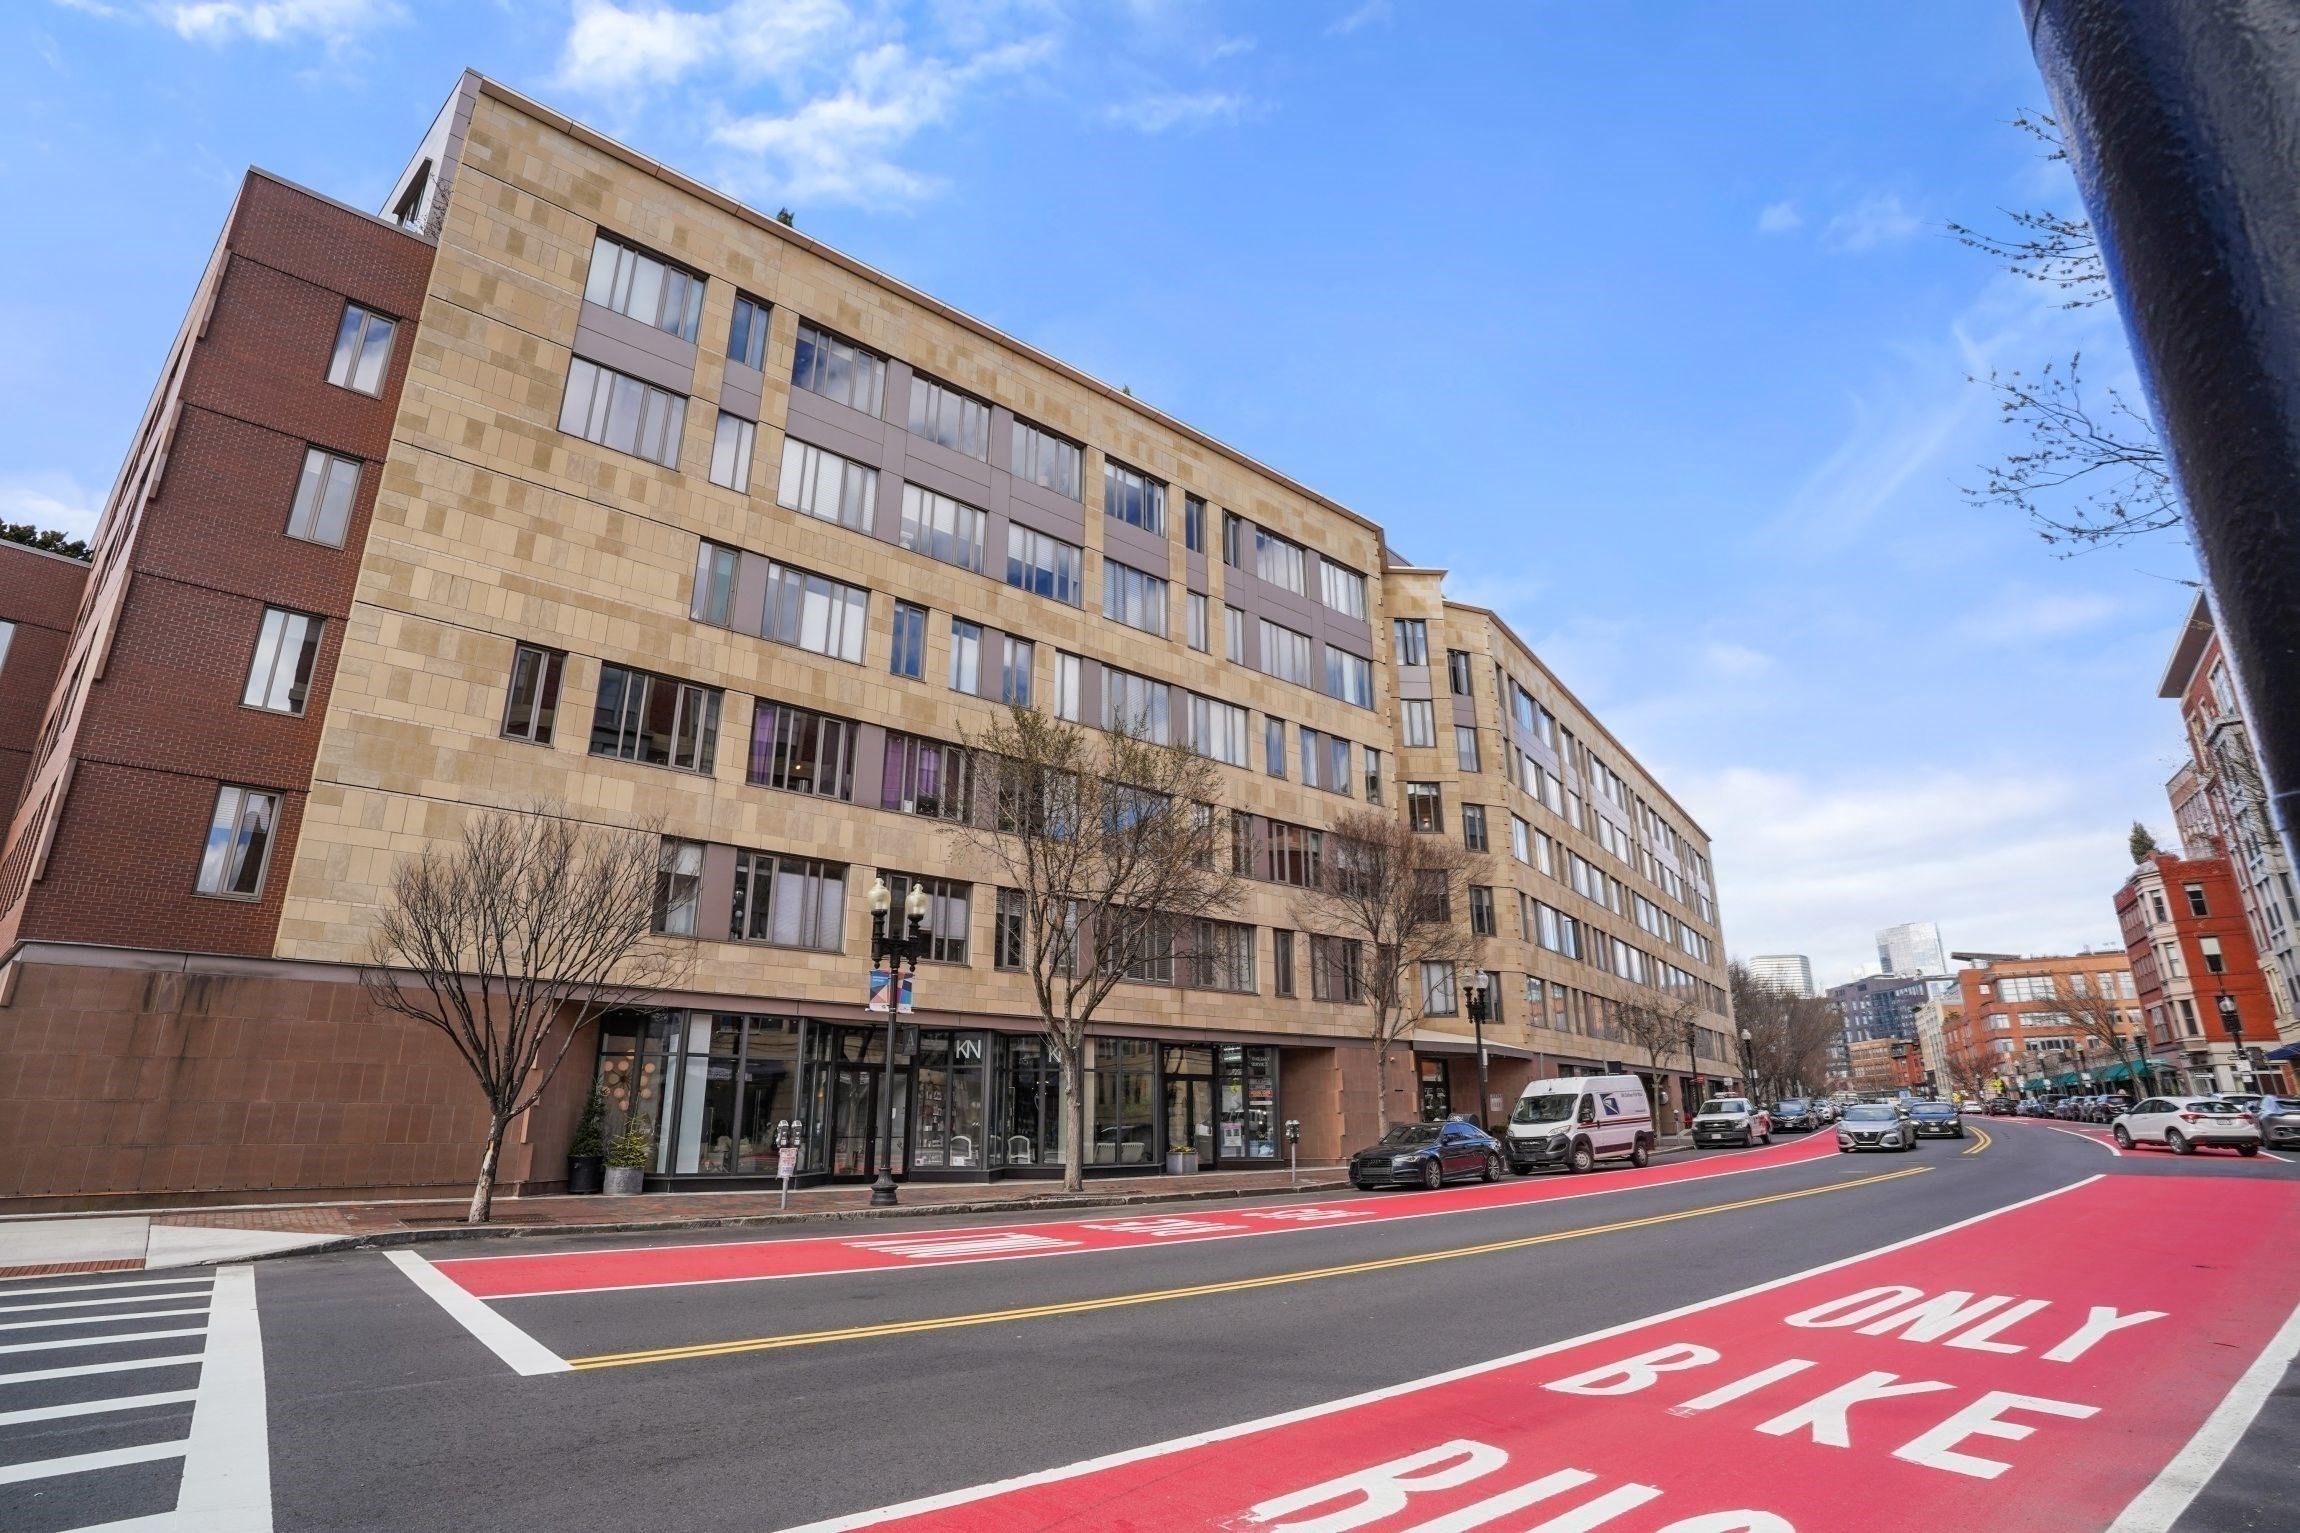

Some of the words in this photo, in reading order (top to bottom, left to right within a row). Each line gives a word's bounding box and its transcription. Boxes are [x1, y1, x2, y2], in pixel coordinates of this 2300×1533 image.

[956, 1039, 982, 1059] KN
[1784, 1285, 2168, 1363] ONLY
[1542, 1342, 2101, 1479] BIKE
[1236, 1438, 1796, 1533] BU
